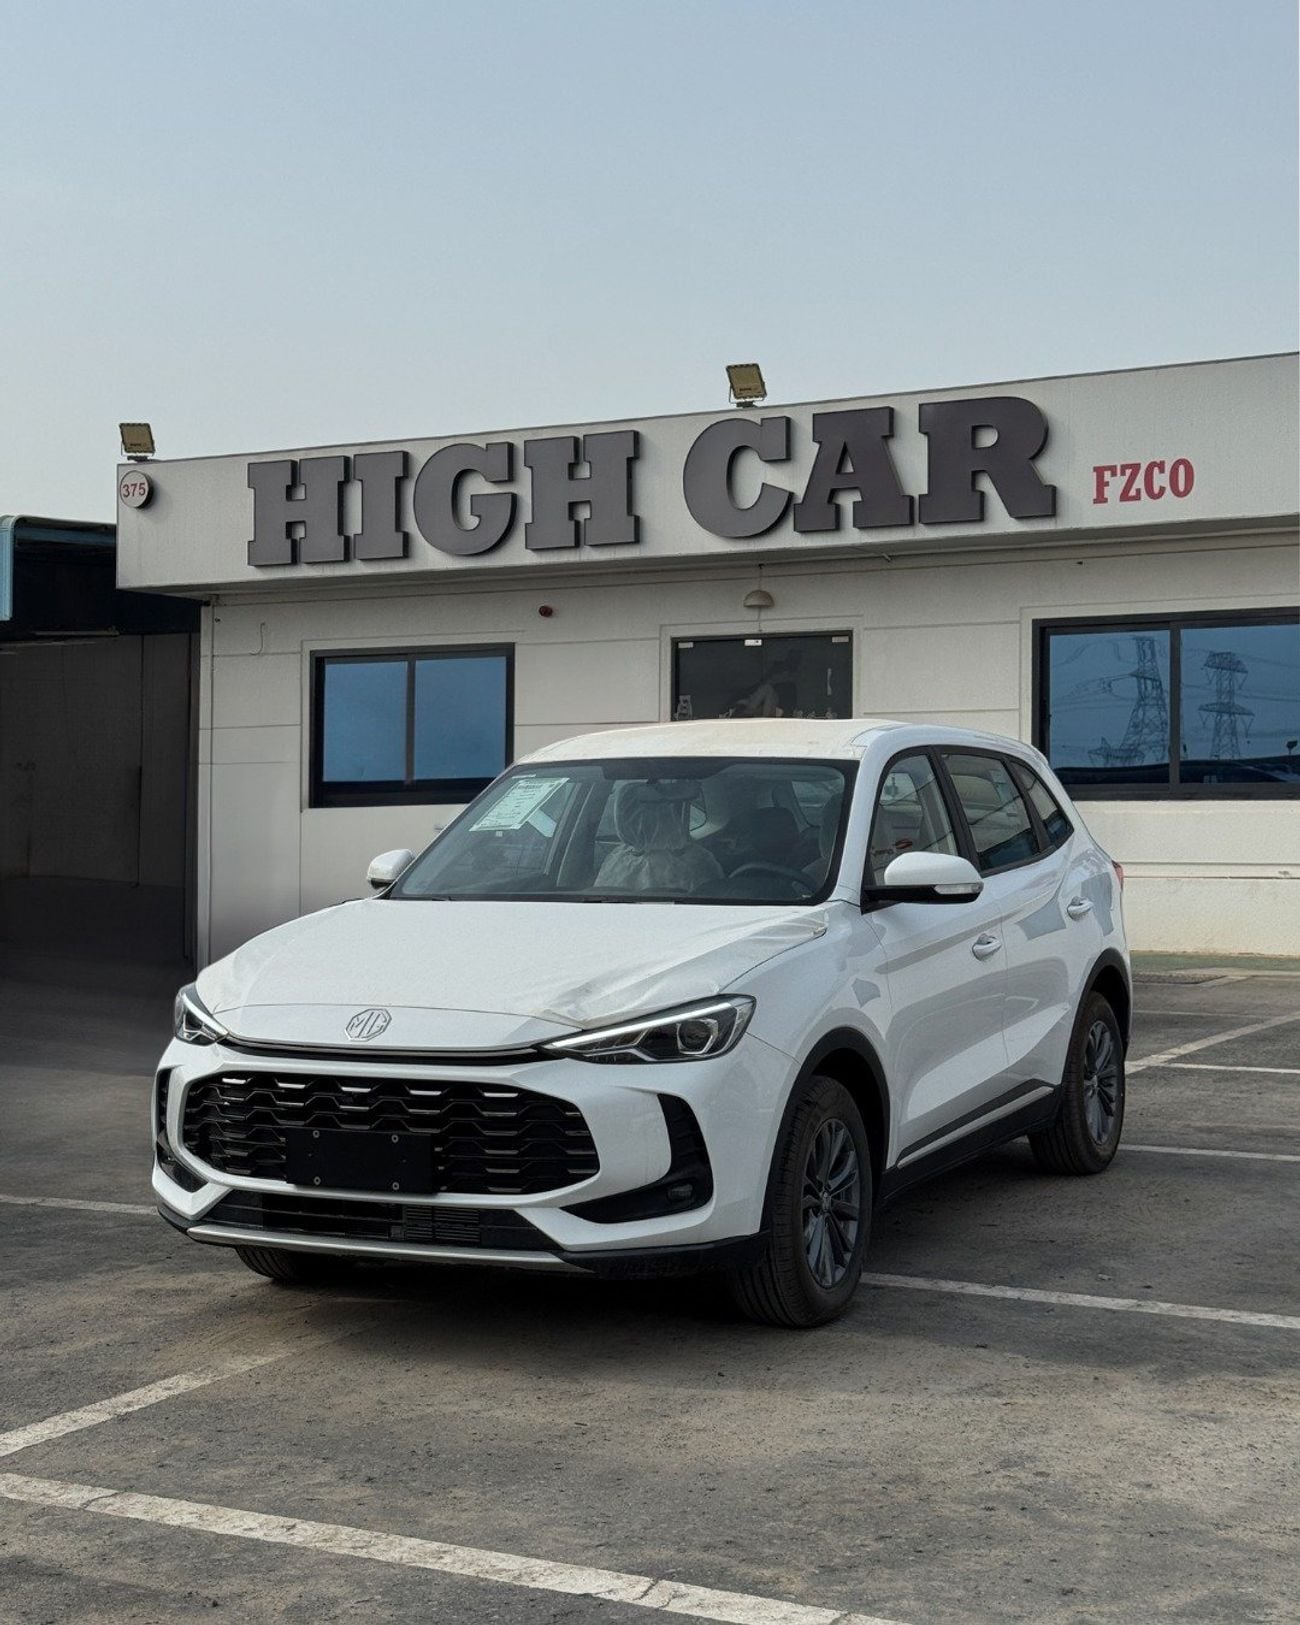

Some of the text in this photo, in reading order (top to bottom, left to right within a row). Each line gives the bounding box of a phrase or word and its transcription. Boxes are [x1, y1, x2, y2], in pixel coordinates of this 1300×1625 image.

[122, 482, 146, 498] 375
[247, 396, 1195, 567] HIGH CAR FZCO
[347, 1010, 390, 1040] MG
